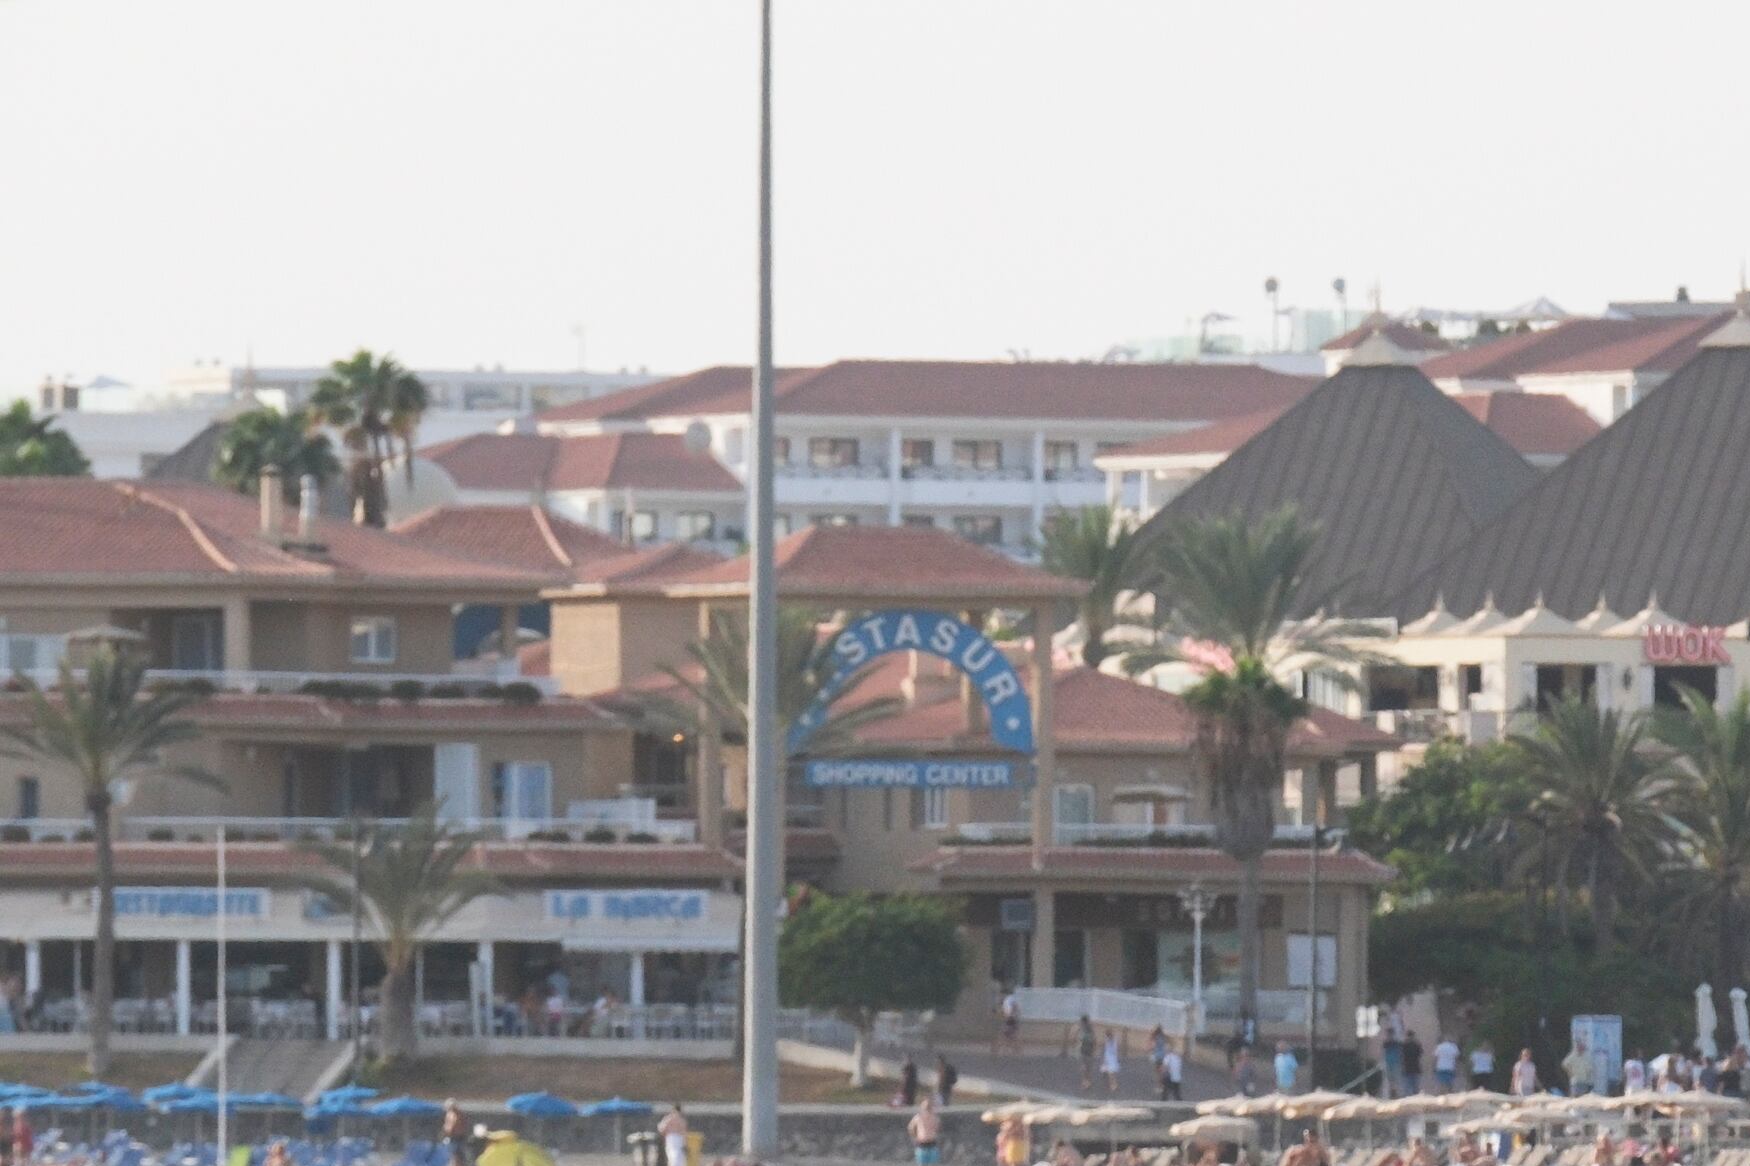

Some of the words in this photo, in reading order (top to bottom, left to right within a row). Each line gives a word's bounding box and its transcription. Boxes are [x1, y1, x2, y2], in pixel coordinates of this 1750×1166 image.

[1645, 625, 1732, 664] WOK
[810, 761, 919, 786] SHOPPING
[924, 761, 1010, 786] CENTER
